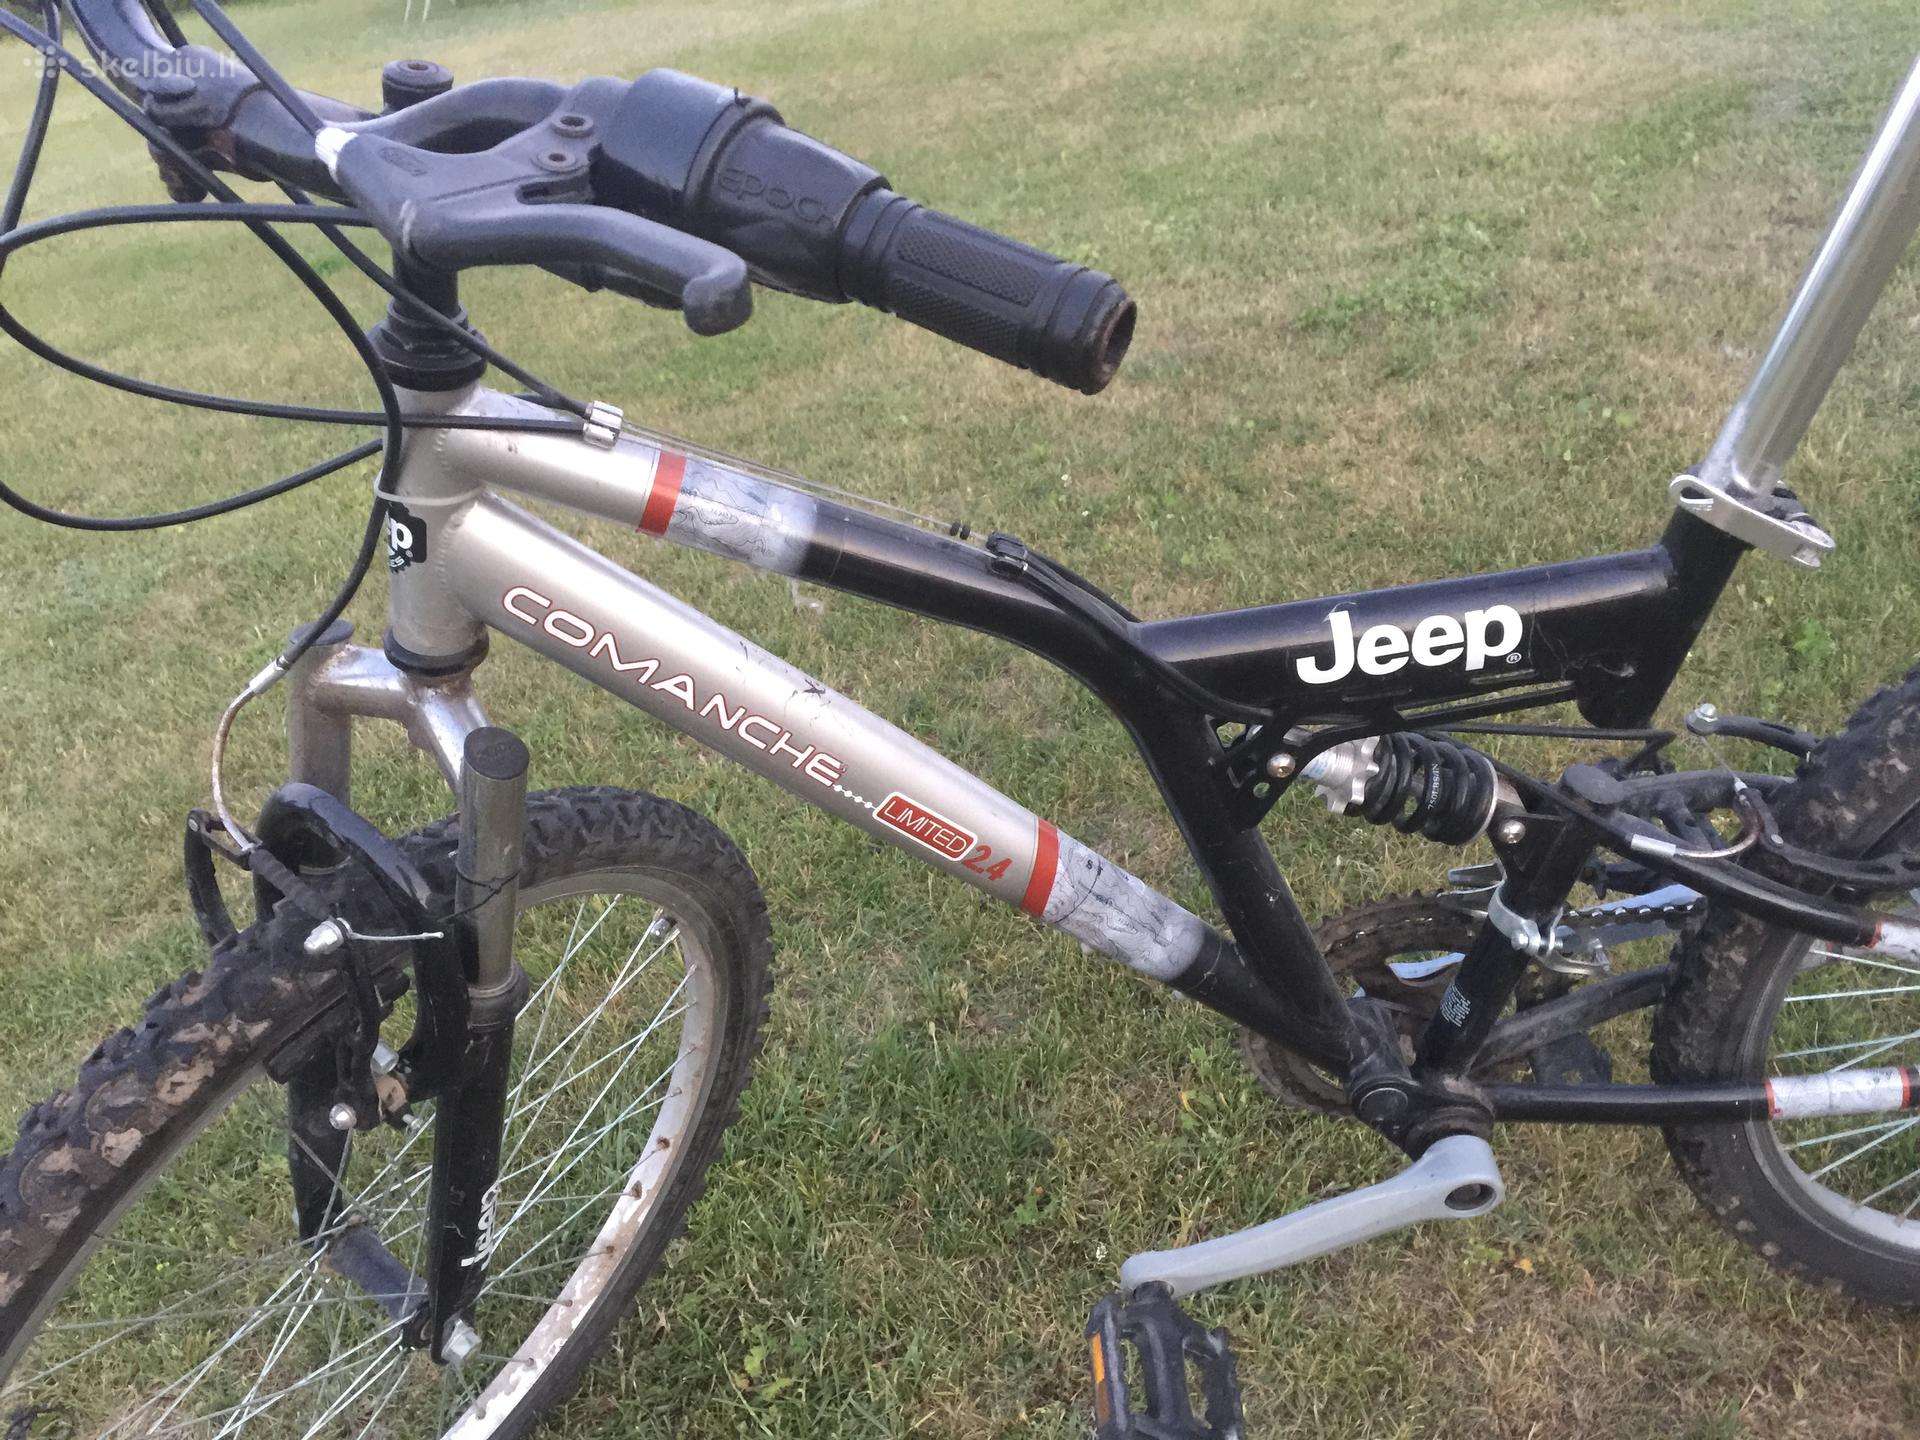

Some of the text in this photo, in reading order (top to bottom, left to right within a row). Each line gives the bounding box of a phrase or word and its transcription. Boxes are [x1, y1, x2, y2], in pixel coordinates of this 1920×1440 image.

[502, 586, 844, 788] COMANCHE
[883, 800, 967, 853] LIMITED
[962, 844, 1013, 881] 24
